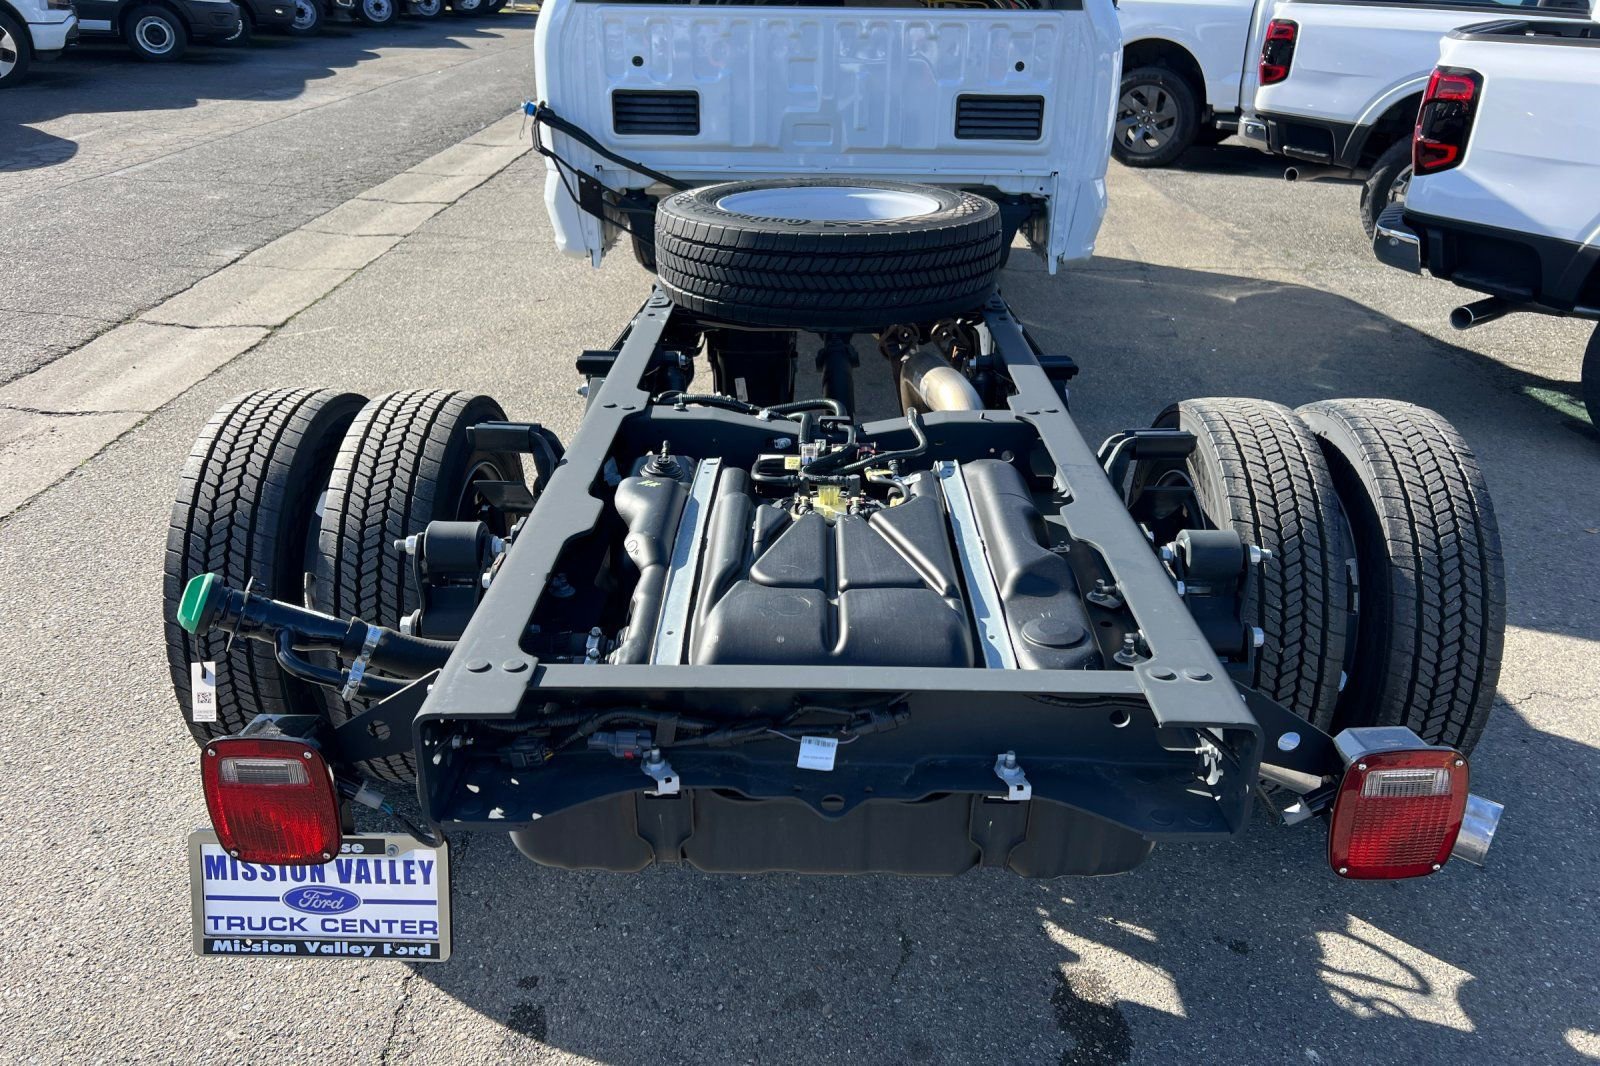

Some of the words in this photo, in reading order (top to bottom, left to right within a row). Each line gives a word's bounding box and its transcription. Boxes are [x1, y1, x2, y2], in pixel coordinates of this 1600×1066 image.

[205, 855, 326, 883] MISSION
[335, 858, 434, 885] VALLEY
[298, 890, 344, 910] Ford
[207, 915, 309, 932] TRUCK
[320, 918, 438, 935] CENTER
[212, 939, 297, 953] Mission
[303, 942, 376, 957] Valley
[383, 943, 431, 956] Ford
